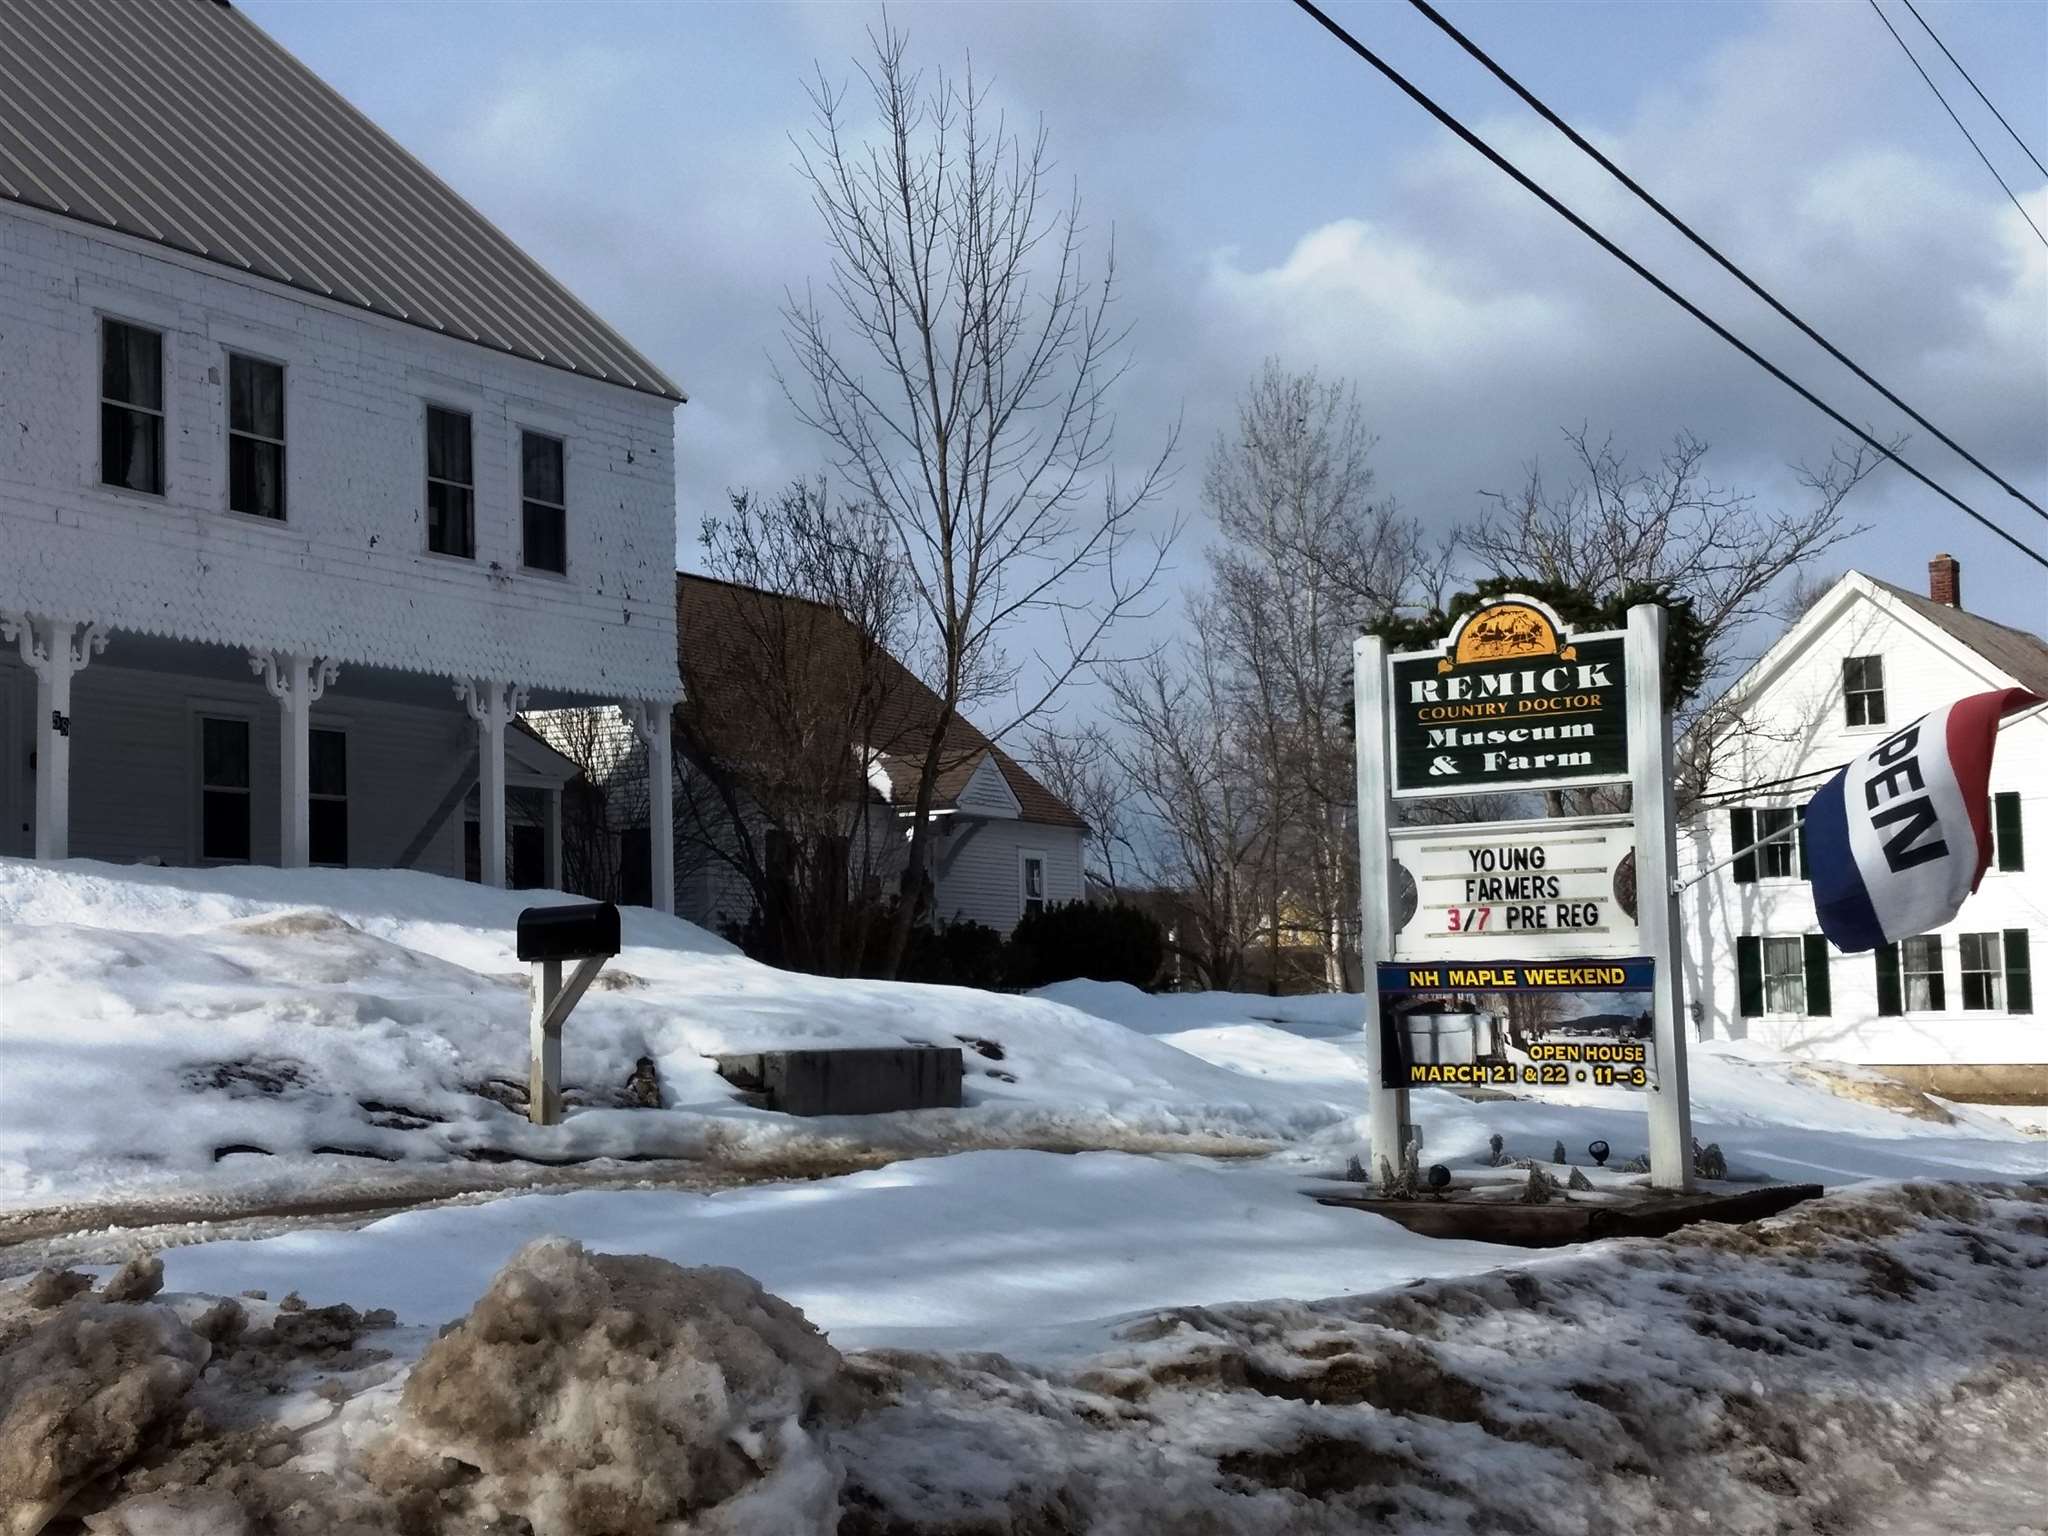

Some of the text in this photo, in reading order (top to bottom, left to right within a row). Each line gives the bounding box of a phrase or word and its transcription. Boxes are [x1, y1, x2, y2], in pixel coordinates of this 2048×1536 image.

[1409, 663, 1613, 704] REMICK
[1418, 695, 1602, 721] COUNTRY DOCTOR
[1426, 722, 1595, 749] Museum
[1429, 750, 1593, 776] & Farm
[1865, 712, 1950, 873] PEN
[1468, 846, 1546, 872] YOUNG
[1466, 876, 1560, 902] FARMERS
[1447, 903, 1599, 932] 3/7 PRE REG
[1409, 968, 1626, 987] NH MAPLE WEEKEND
[1530, 1045, 1644, 1062] OPEN HOUSE
[1410, 1066, 1488, 1082] MARCH
[1493, 1066, 1516, 1082] 21
[1525, 1066, 1537, 1082] &
[1543, 1067, 1568, 1083] 22
